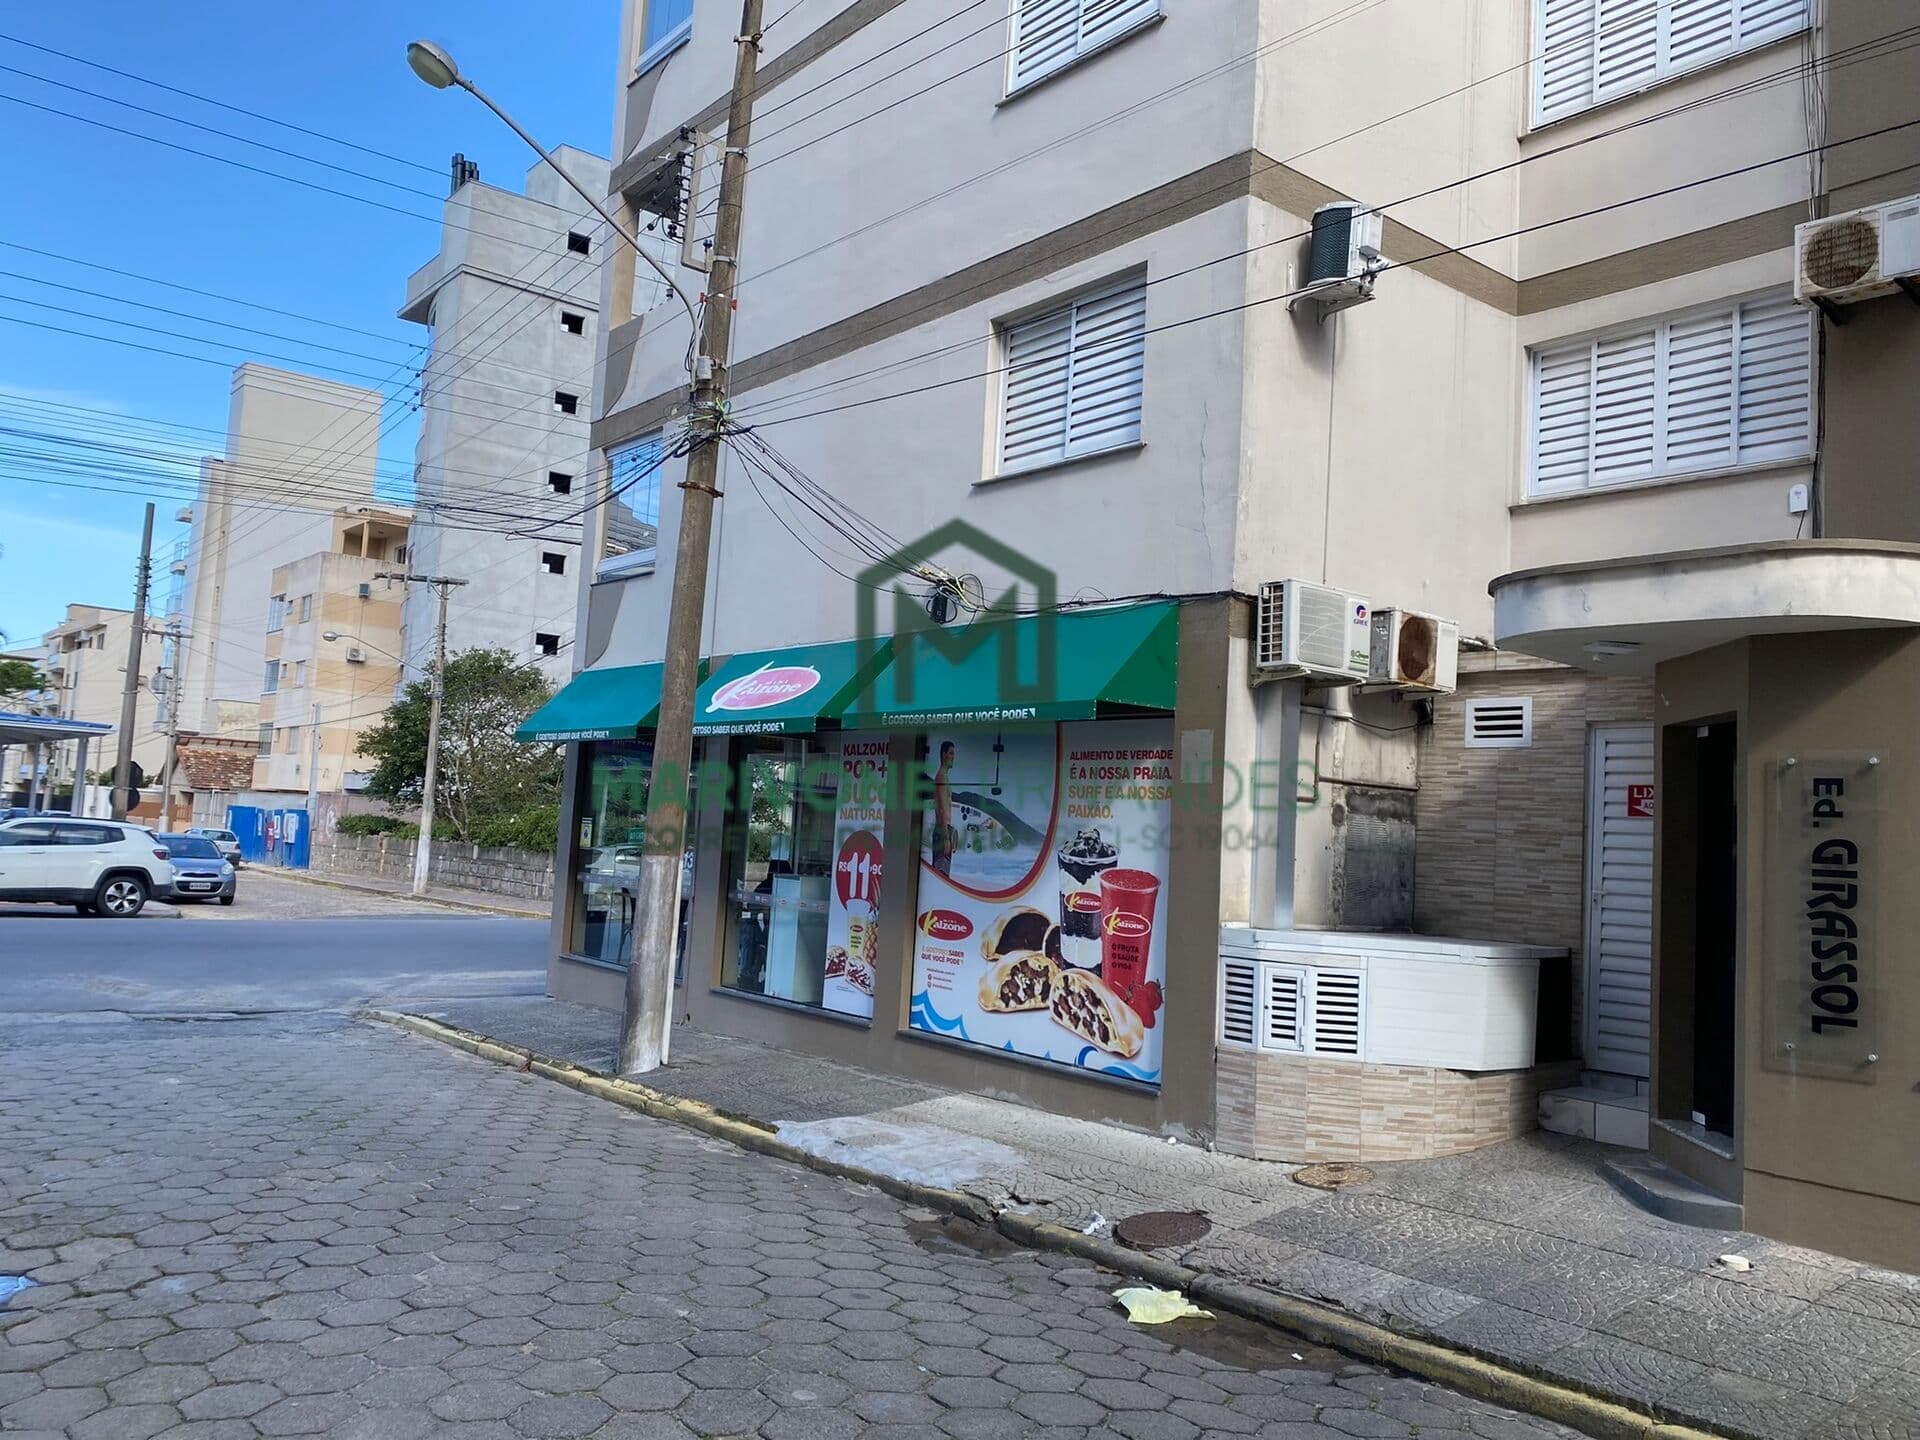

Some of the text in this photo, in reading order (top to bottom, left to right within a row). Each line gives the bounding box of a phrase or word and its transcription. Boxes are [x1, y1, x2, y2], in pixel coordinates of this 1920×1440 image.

[888, 713, 924, 726] GOSTOSO
[926, 712, 953, 724] SABER
[954, 711, 974, 724] QUE
[975, 707, 1000, 722] VOCÊ
[1001, 708, 1028, 720] PODE
[712, 724, 730, 734] SABER
[731, 723, 744, 734] QUE
[745, 720, 761, 733] VOCÊ
[762, 722, 780, 732] PODE
[1070, 749, 1173, 761] ALIMENTO DE VERDADE
[1069, 763, 1173, 780] É A NOSSA PRAIA.
[1068, 781, 1173, 800] SURF É A NOSSA
[1067, 801, 1114, 819] PAIXÃO.
[1813, 777, 1844, 828] Ed.
[847, 852, 871, 899] 11
[1806, 838, 1859, 1035] GIRASSOL
